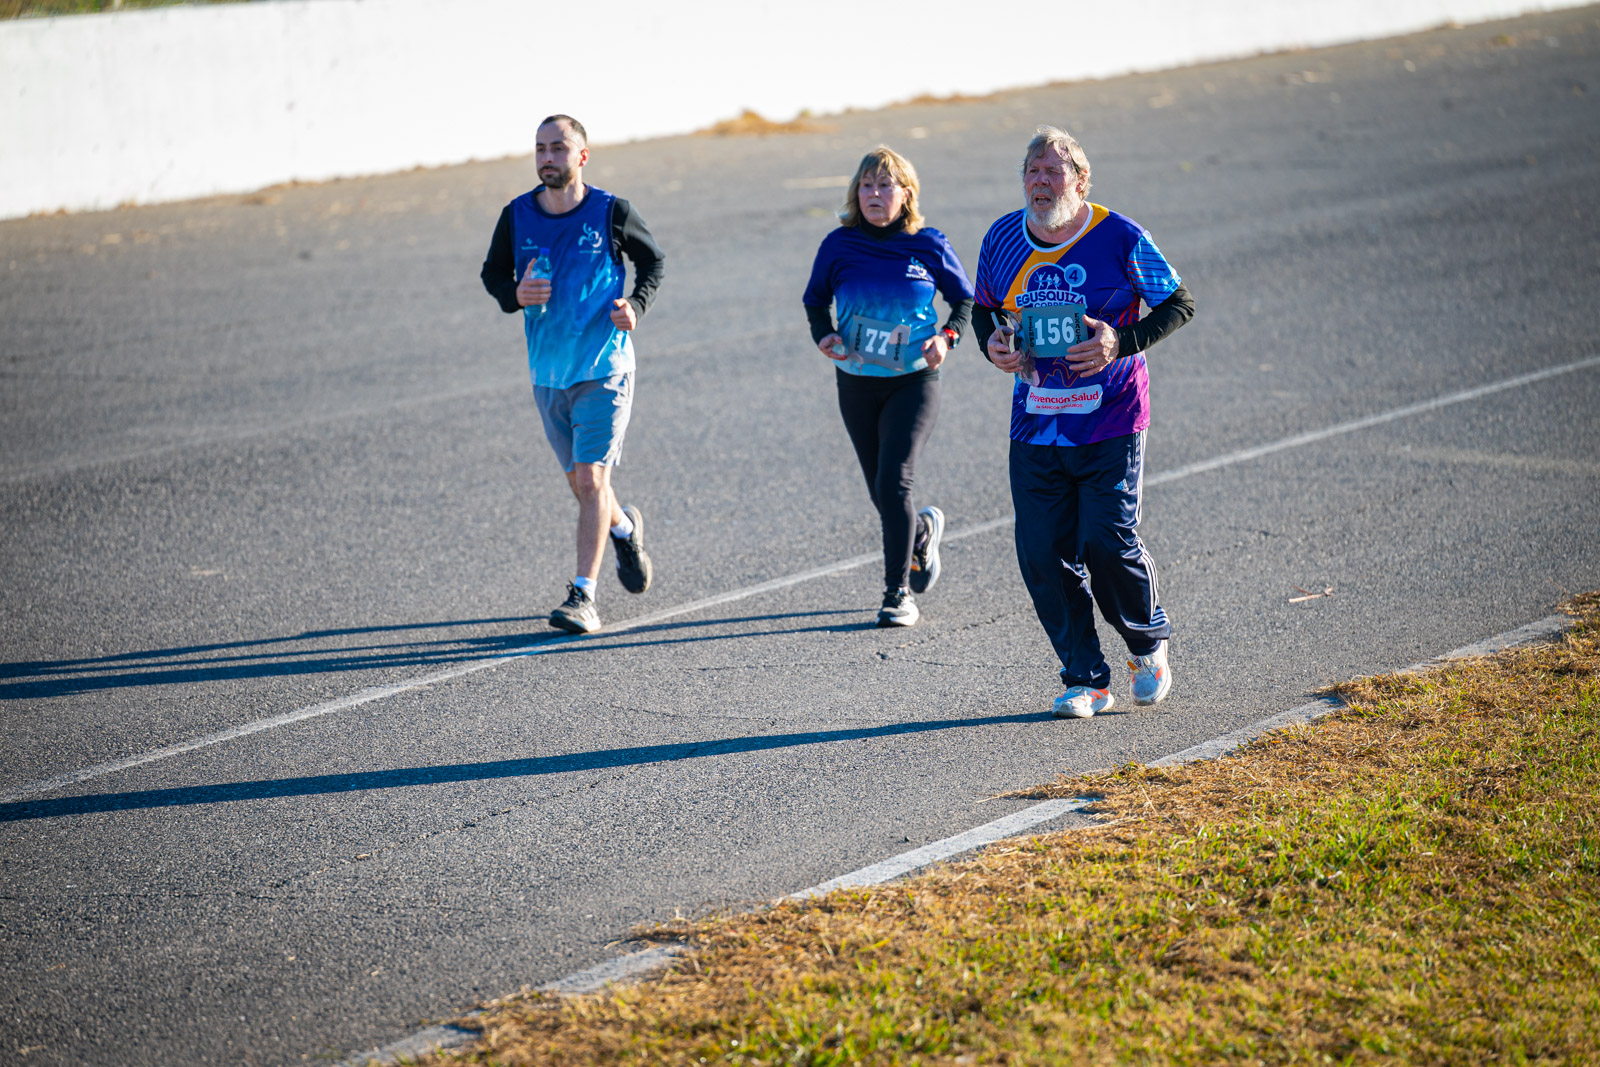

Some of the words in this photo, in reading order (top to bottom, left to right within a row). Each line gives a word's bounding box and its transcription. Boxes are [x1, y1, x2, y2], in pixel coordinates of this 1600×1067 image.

[1068, 269, 1079, 282] 4
[1016, 290, 1085, 307] EGUSQUIZA
[1034, 316, 1075, 346] 156
[864, 327, 892, 356] 77
[1028, 391, 1071, 404] Prevención
[1071, 390, 1099, 402] Salud
